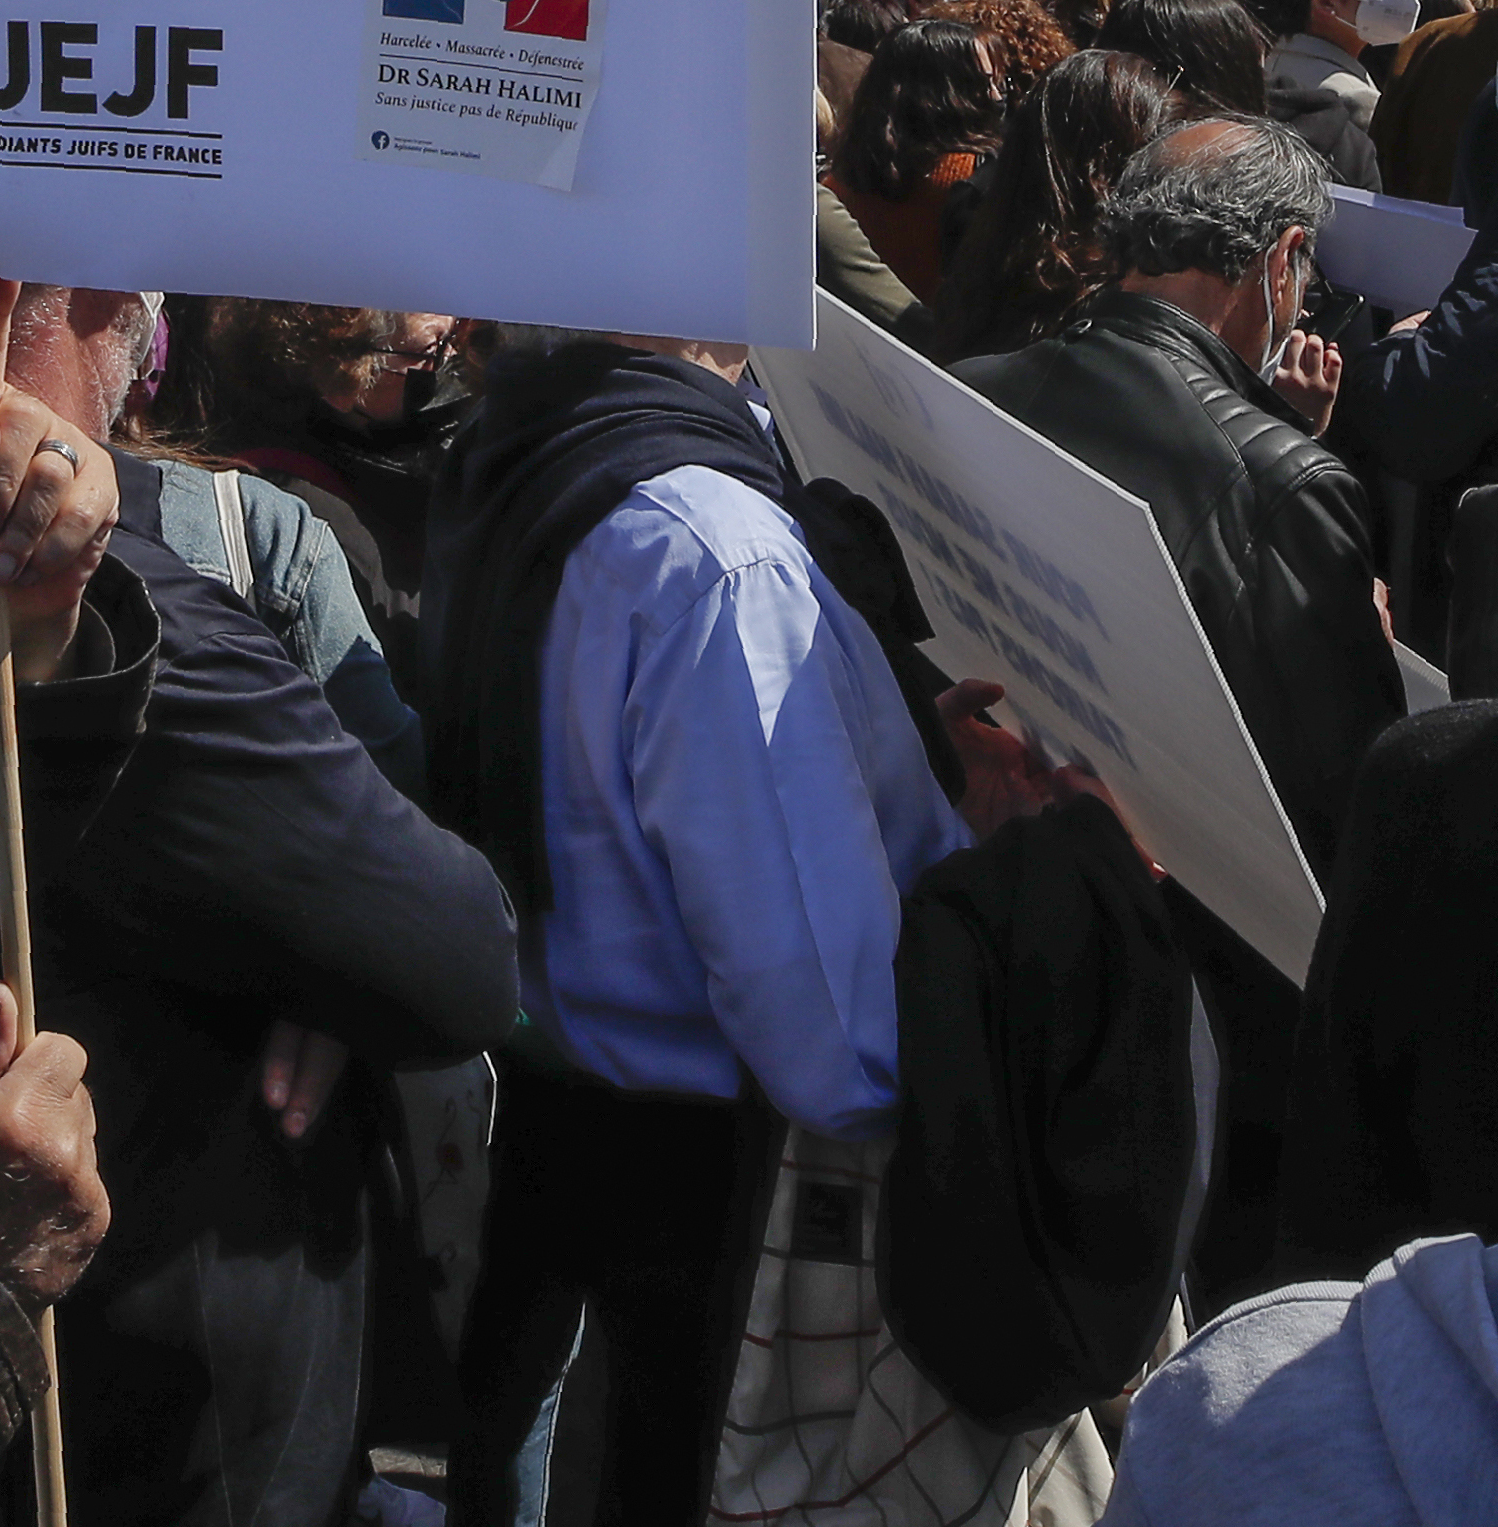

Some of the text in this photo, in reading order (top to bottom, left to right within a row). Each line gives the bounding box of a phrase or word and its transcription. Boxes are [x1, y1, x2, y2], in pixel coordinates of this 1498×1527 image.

[379, 32, 585, 71] Harcelée Massacrée Défenestrée
[377, 64, 582, 109] DR SARAH HALIMI
[375, 91, 407, 107] Sans
[409, 94, 456, 113] justice
[459, 104, 482, 118] pas
[486, 104, 501, 119] de
[67, 139, 118, 157] JUIFS
[124, 143, 147, 160] DE
[152, 144, 222, 165] FRANCE
